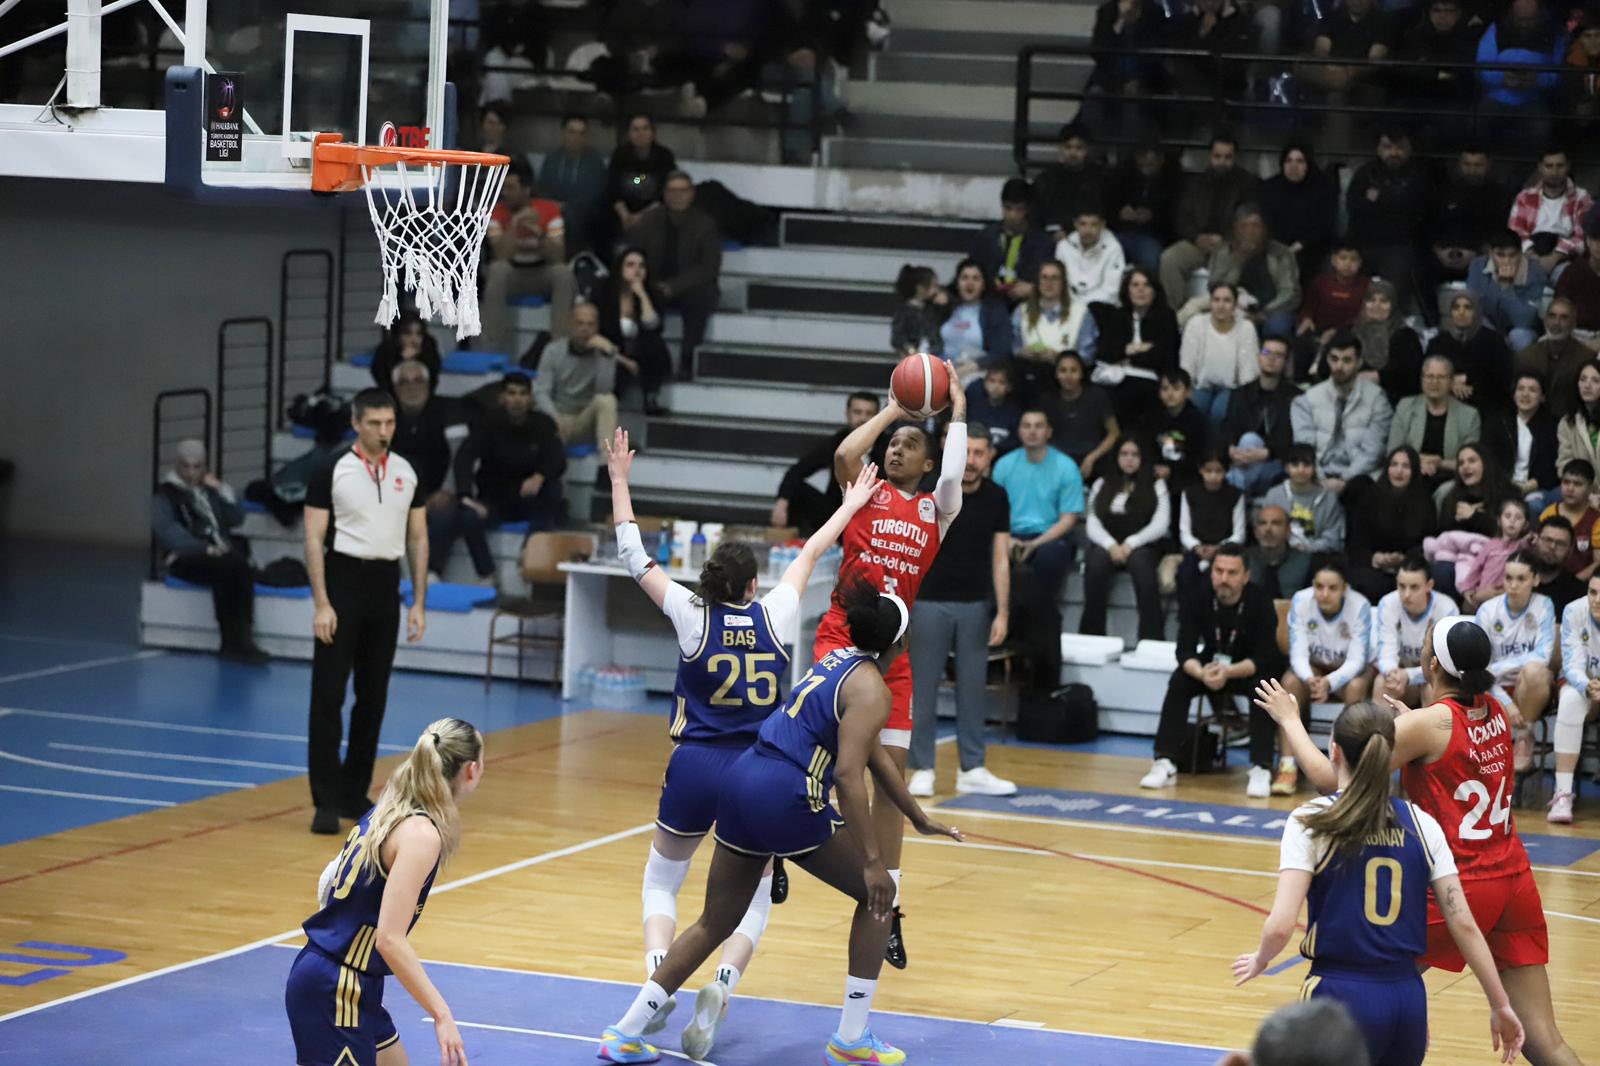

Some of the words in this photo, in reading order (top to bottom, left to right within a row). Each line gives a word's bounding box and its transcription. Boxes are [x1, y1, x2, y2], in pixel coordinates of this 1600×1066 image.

[210, 140, 238, 148] BASKETBOL
[870, 537, 922, 558] BELEDİYESİ
[871, 519, 928, 548] TURGUTLU
[722, 629, 757, 650] BAŞ
[707, 653, 778, 706] 25
[1453, 776, 1512, 840] 24
[1364, 856, 1403, 926] 0
